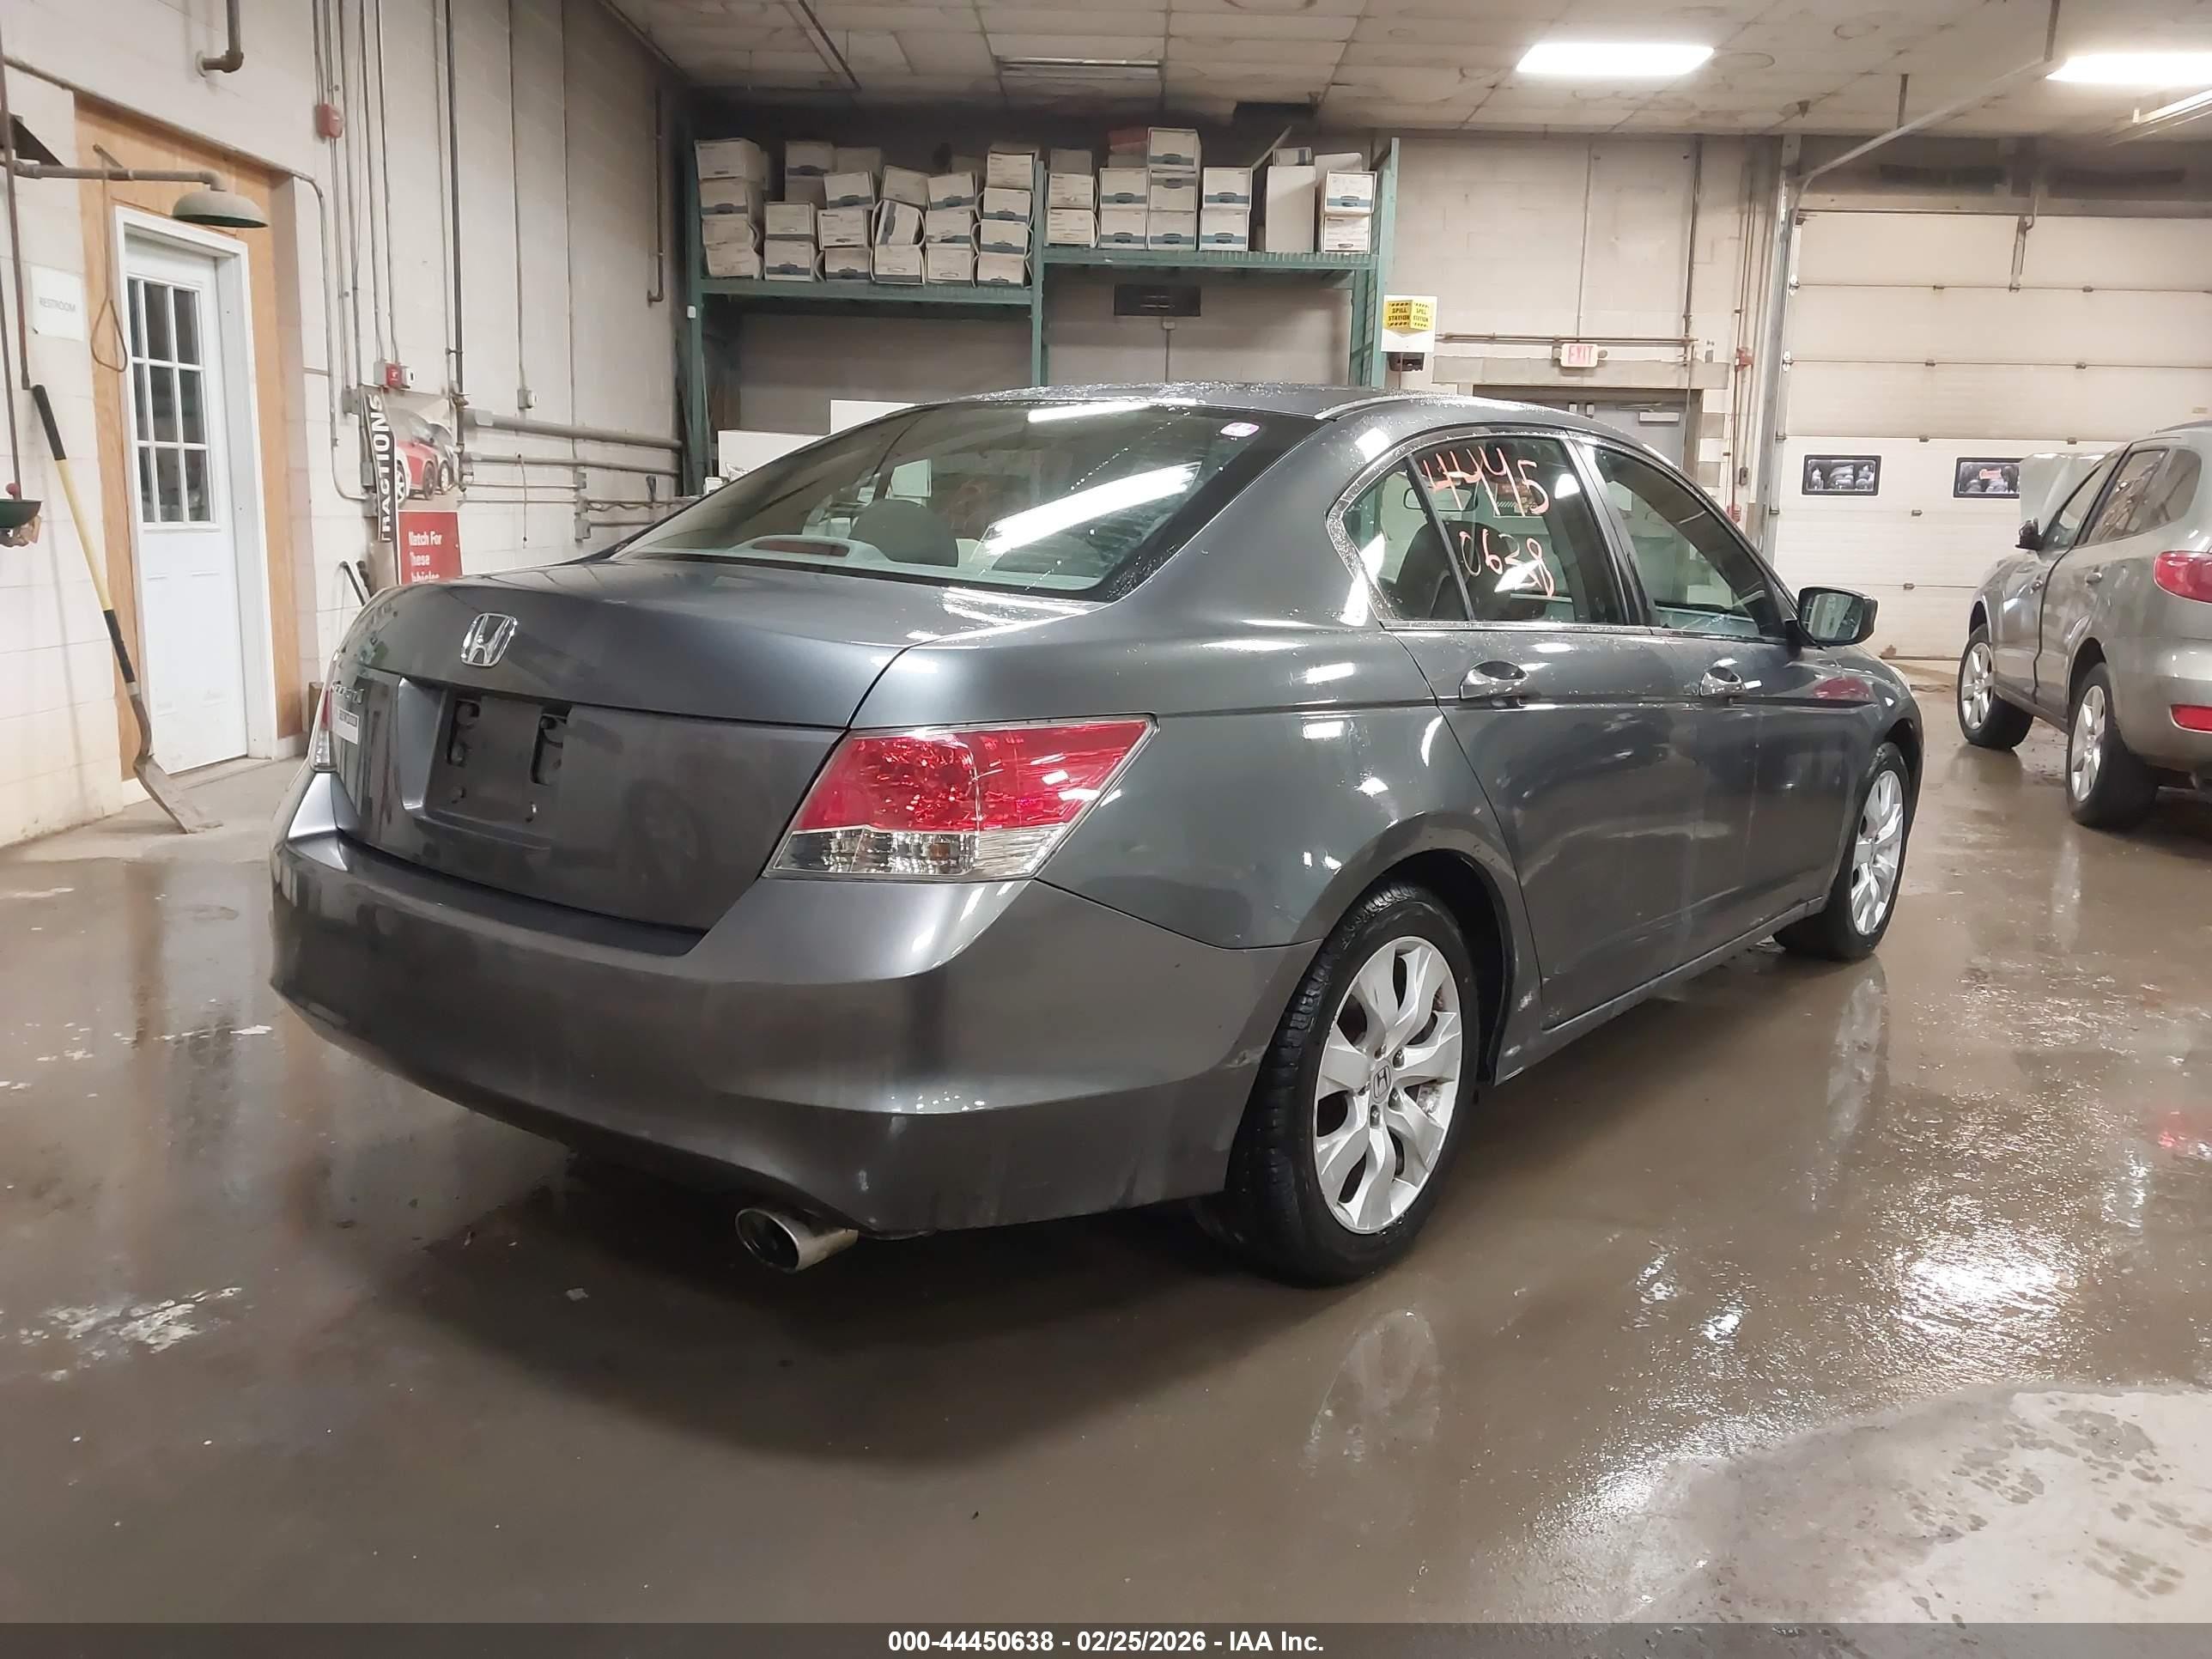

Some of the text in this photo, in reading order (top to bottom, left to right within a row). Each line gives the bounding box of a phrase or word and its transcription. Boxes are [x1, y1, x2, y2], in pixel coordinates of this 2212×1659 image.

[39, 296, 76, 313] RESTROOM
[1568, 345, 1594, 365] EXIT
[1423, 446, 1550, 516] 4445
[430, 530, 443, 545] For
